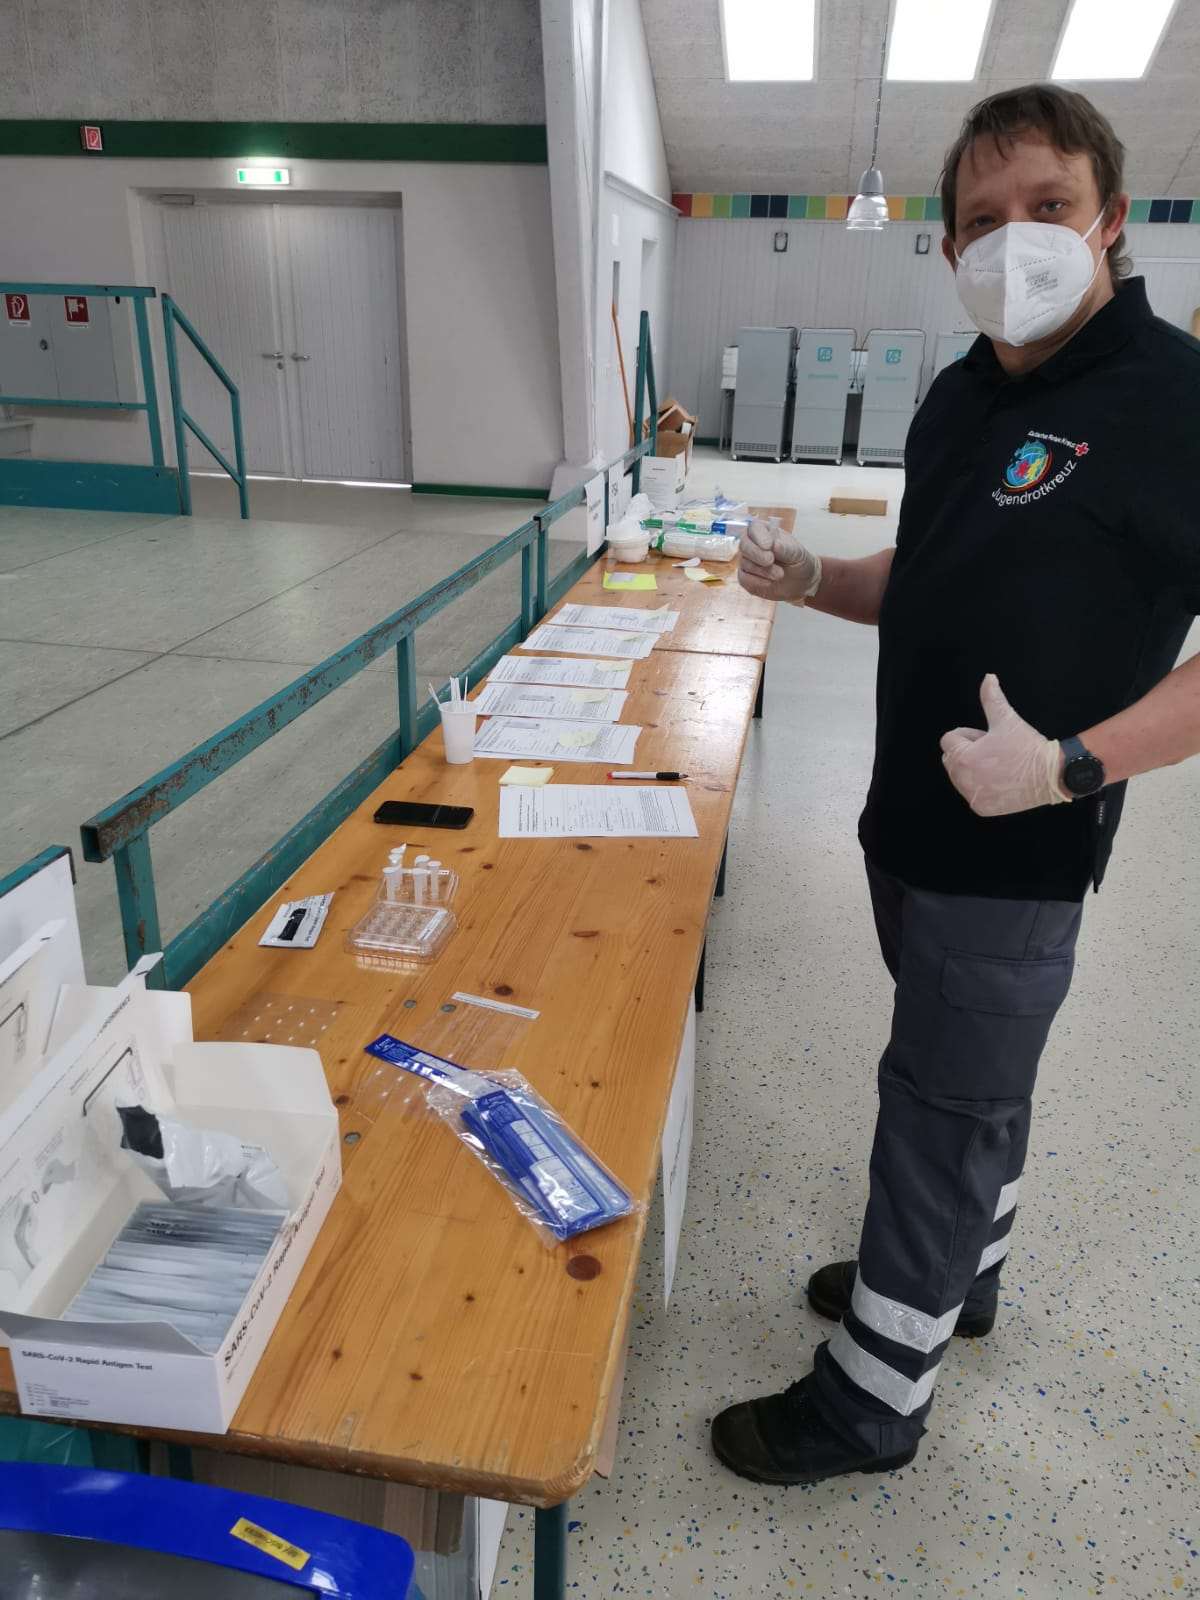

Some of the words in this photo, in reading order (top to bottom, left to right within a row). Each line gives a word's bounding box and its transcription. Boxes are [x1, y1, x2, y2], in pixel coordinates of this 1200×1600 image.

[991, 460, 1077, 507] Jugendrotkreuz
[224, 1273, 272, 1367] SARS-CoV-2
[22, 1350, 73, 1363] SARS-CoV-2
[76, 1356, 100, 1366] Rapid
[102, 1360, 134, 1369] Antigen
[136, 1362, 153, 1370] Test
